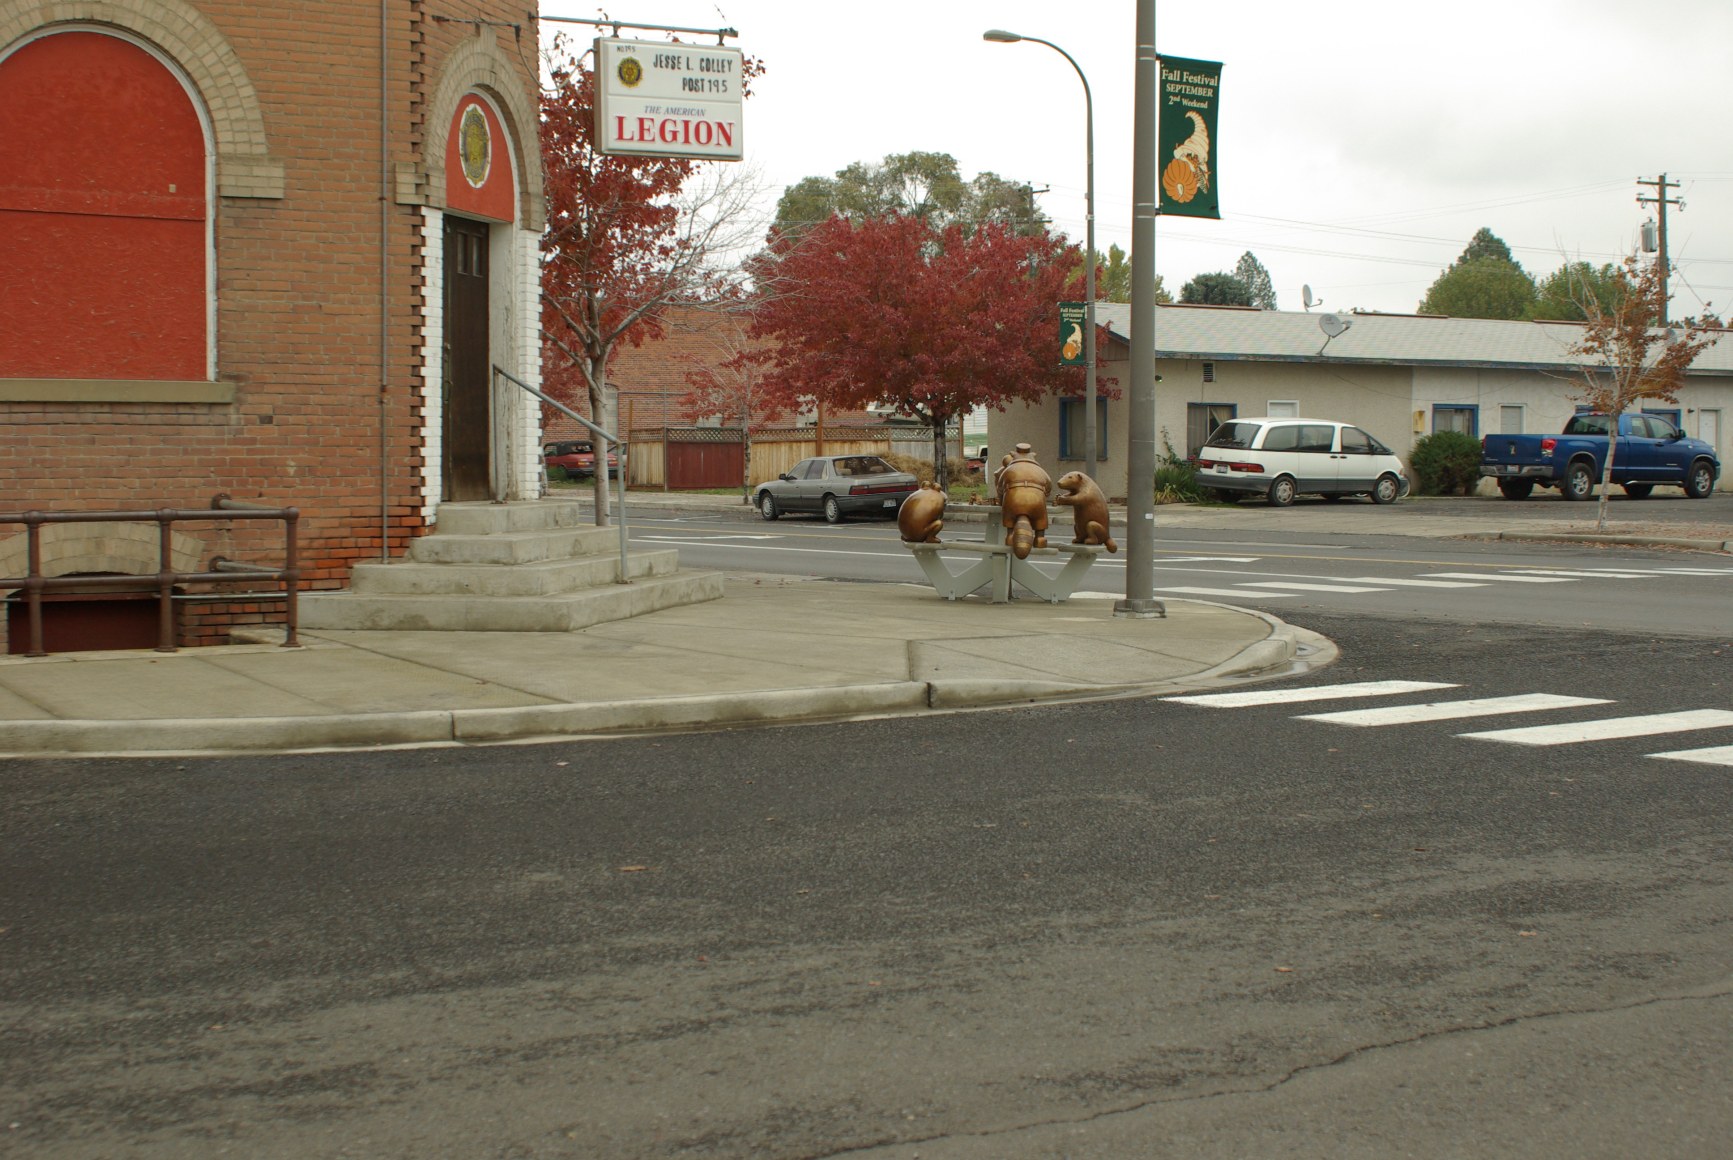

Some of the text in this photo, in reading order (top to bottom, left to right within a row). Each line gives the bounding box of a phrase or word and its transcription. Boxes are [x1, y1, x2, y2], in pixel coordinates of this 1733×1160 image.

[653, 54, 681, 70] JESSE
[686, 57, 694, 70] L.
[700, 58, 733, 73] COLLEY
[1162, 69, 1218, 86] Fall Festival
[682, 78, 728, 93] POST 195
[1166, 83, 1213, 97] SEPTEMBER
[1168, 95, 1208, 108] 2nd Weekend
[644, 106, 706, 117] THE AMERICAN
[615, 116, 734, 147] LEGION
